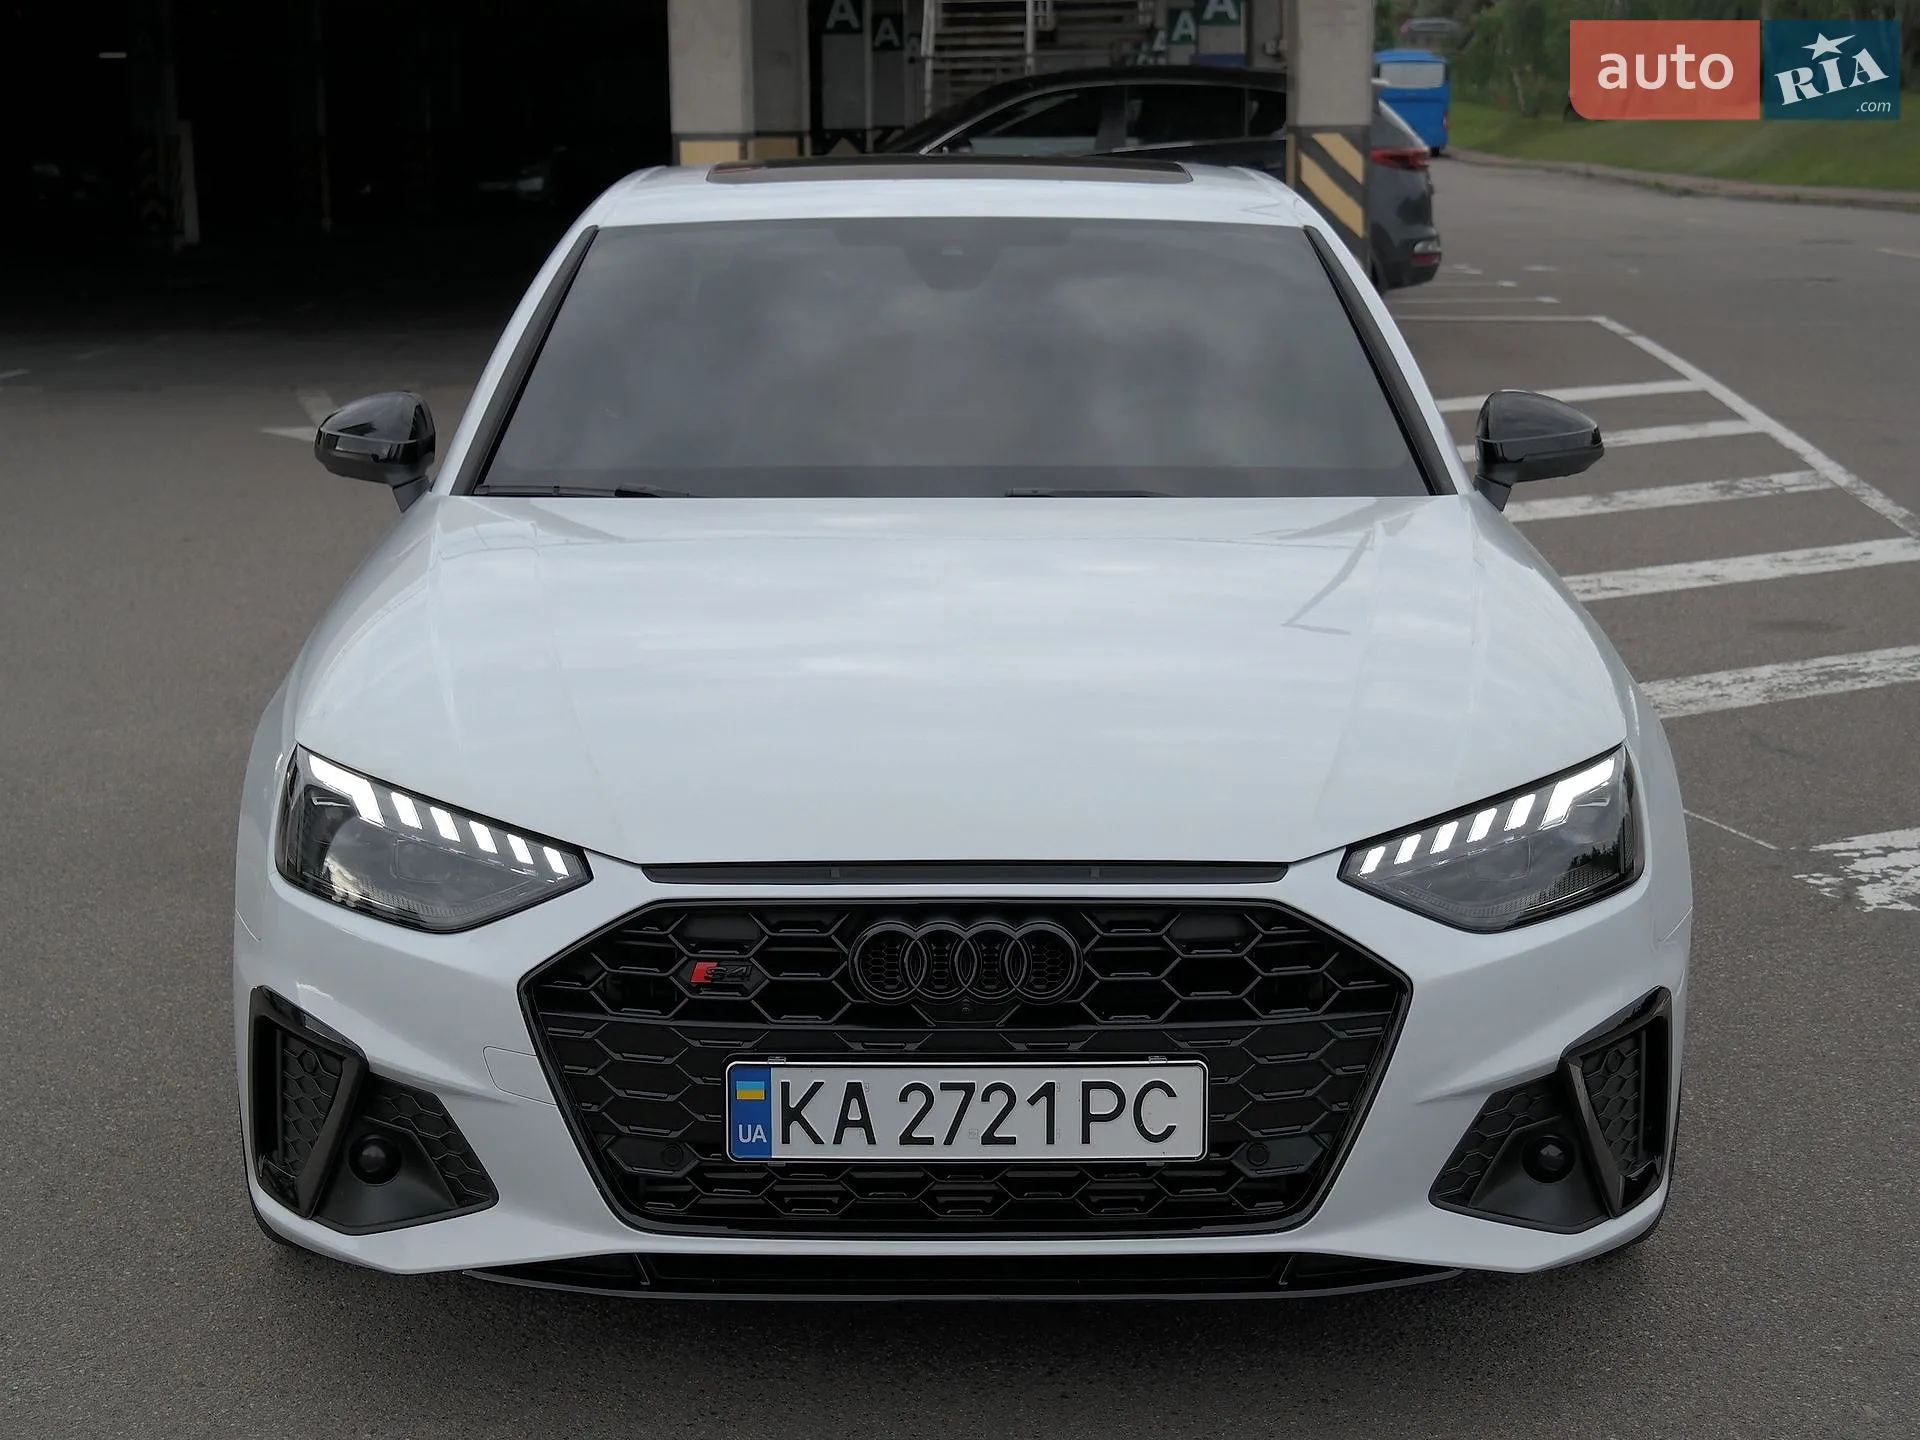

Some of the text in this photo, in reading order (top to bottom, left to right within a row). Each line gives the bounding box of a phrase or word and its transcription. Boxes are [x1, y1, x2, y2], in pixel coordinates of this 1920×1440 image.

[826, 0, 860, 29] A
[1171, 10, 1196, 41] A
[874, 17, 900, 47] A
[780, 1079, 1178, 1146] KA 2721 PC
[738, 1124, 767, 1144] UA
